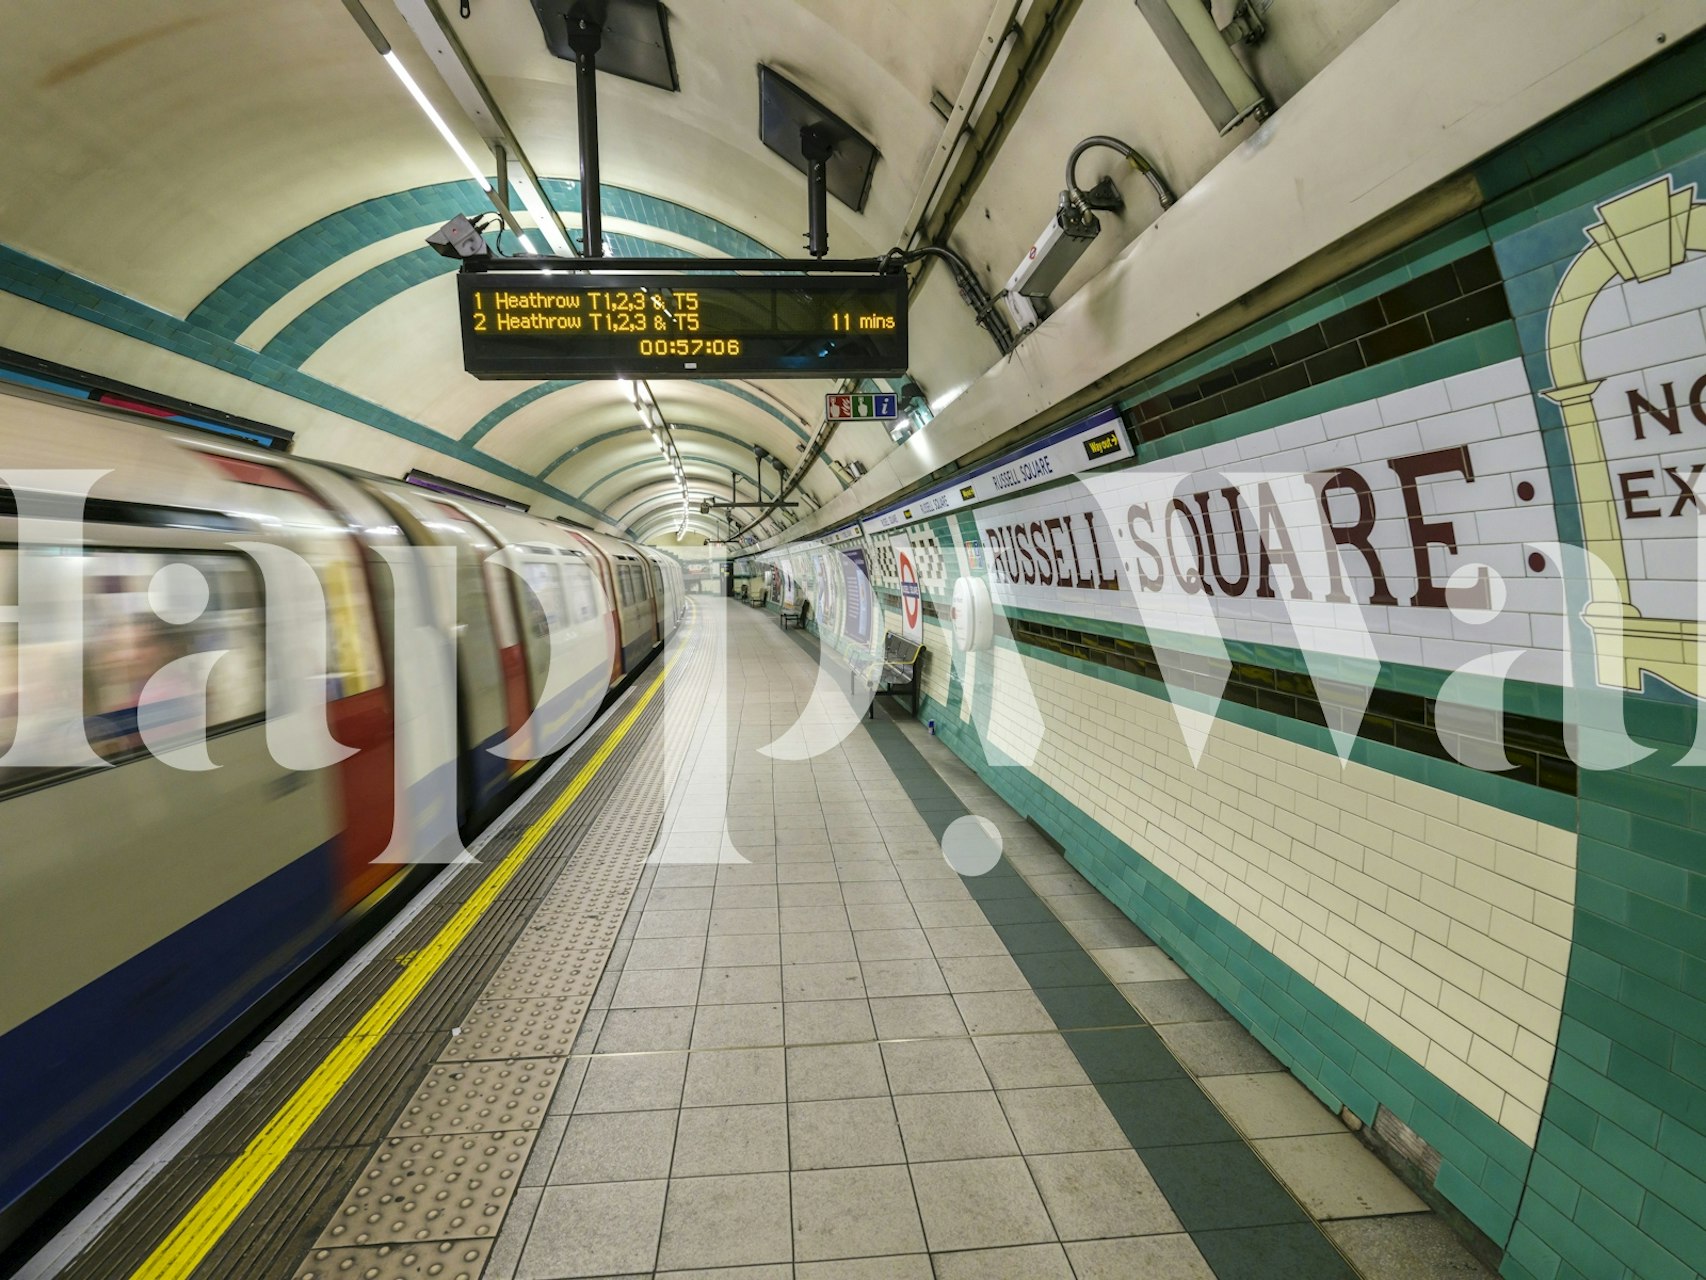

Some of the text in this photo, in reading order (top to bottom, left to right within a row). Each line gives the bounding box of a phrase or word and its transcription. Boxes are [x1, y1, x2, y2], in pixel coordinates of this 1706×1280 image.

[474, 291, 699, 312] 1 Heathrow T1,2,3 & T5
[473, 312, 896, 332] 2 Heathrow T1,2,3 & T5 11 mins
[640, 339, 740, 356] 00:57:06
[1088, 437, 1113, 454] Way out
[992, 455, 1053, 492] RUSSELL SQUARE
